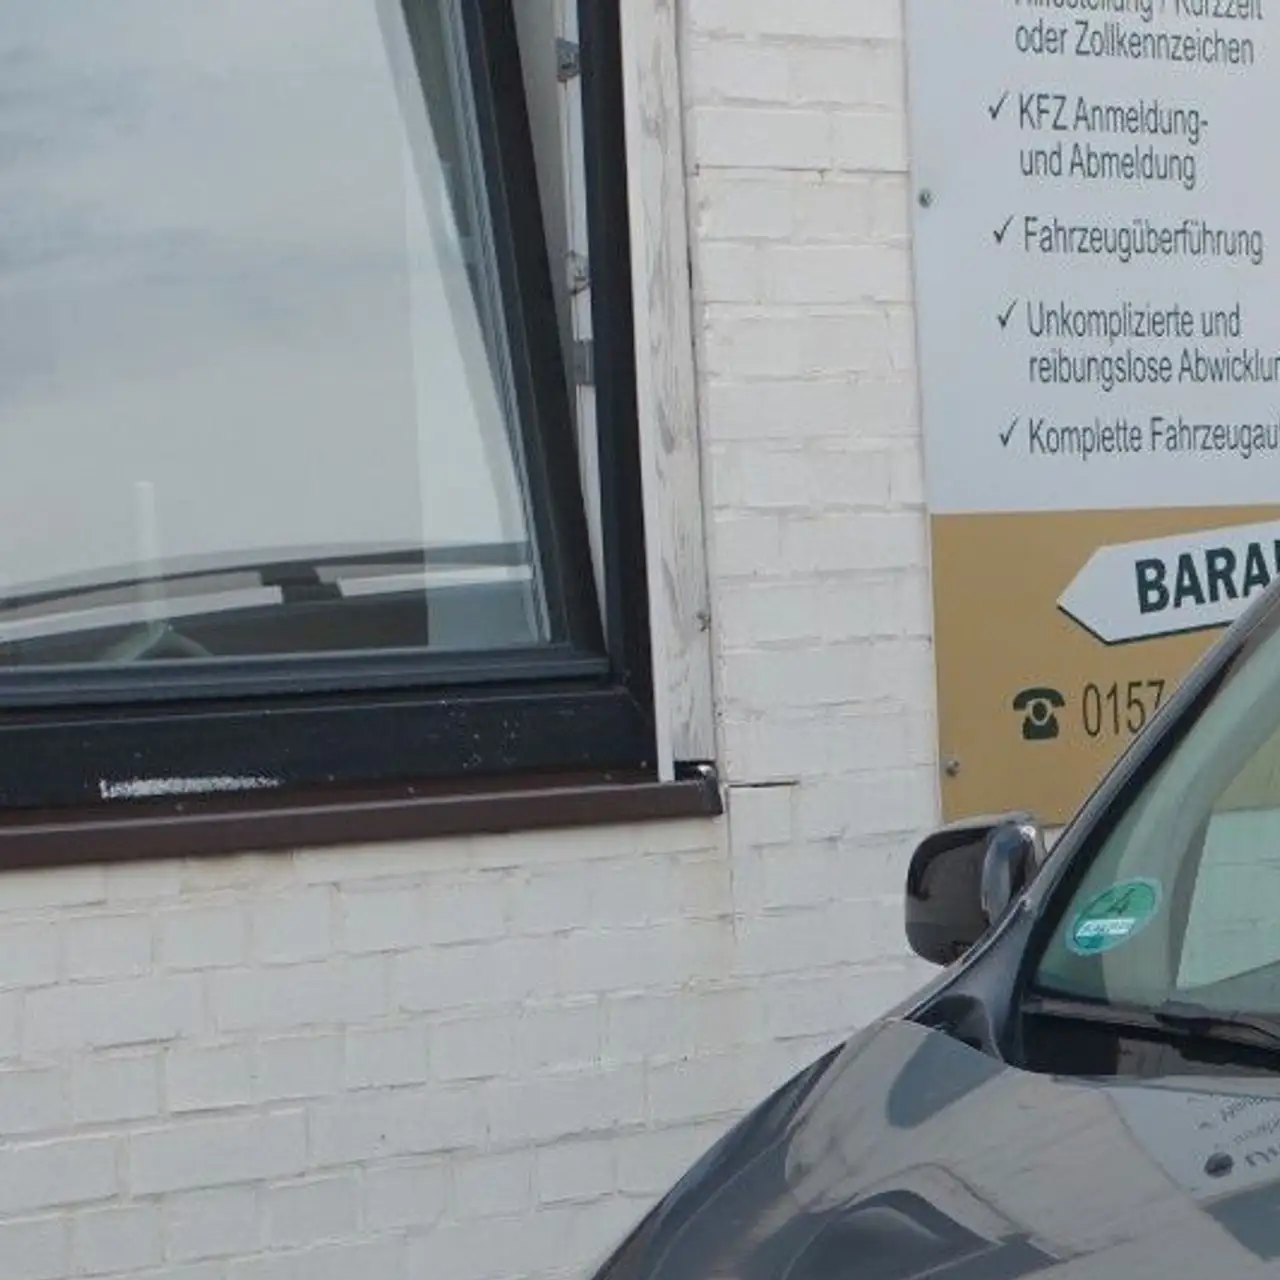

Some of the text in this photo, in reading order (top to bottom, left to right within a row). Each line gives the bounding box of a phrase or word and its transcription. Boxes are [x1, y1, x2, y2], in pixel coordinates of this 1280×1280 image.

[1014, 19, 1254, 65] oder Zollkennzeichen
[1018, 94, 1209, 145] KFZ Anmeldung-
[1020, 141, 1196, 190] und Abmeldung
[1023, 216, 1264, 266] Fahrzeugüberführung
[1027, 302, 1241, 344] Unkomplizierte und
[1029, 350, 1173, 393] reibungslose
[1028, 417, 1143, 462] Komplette
